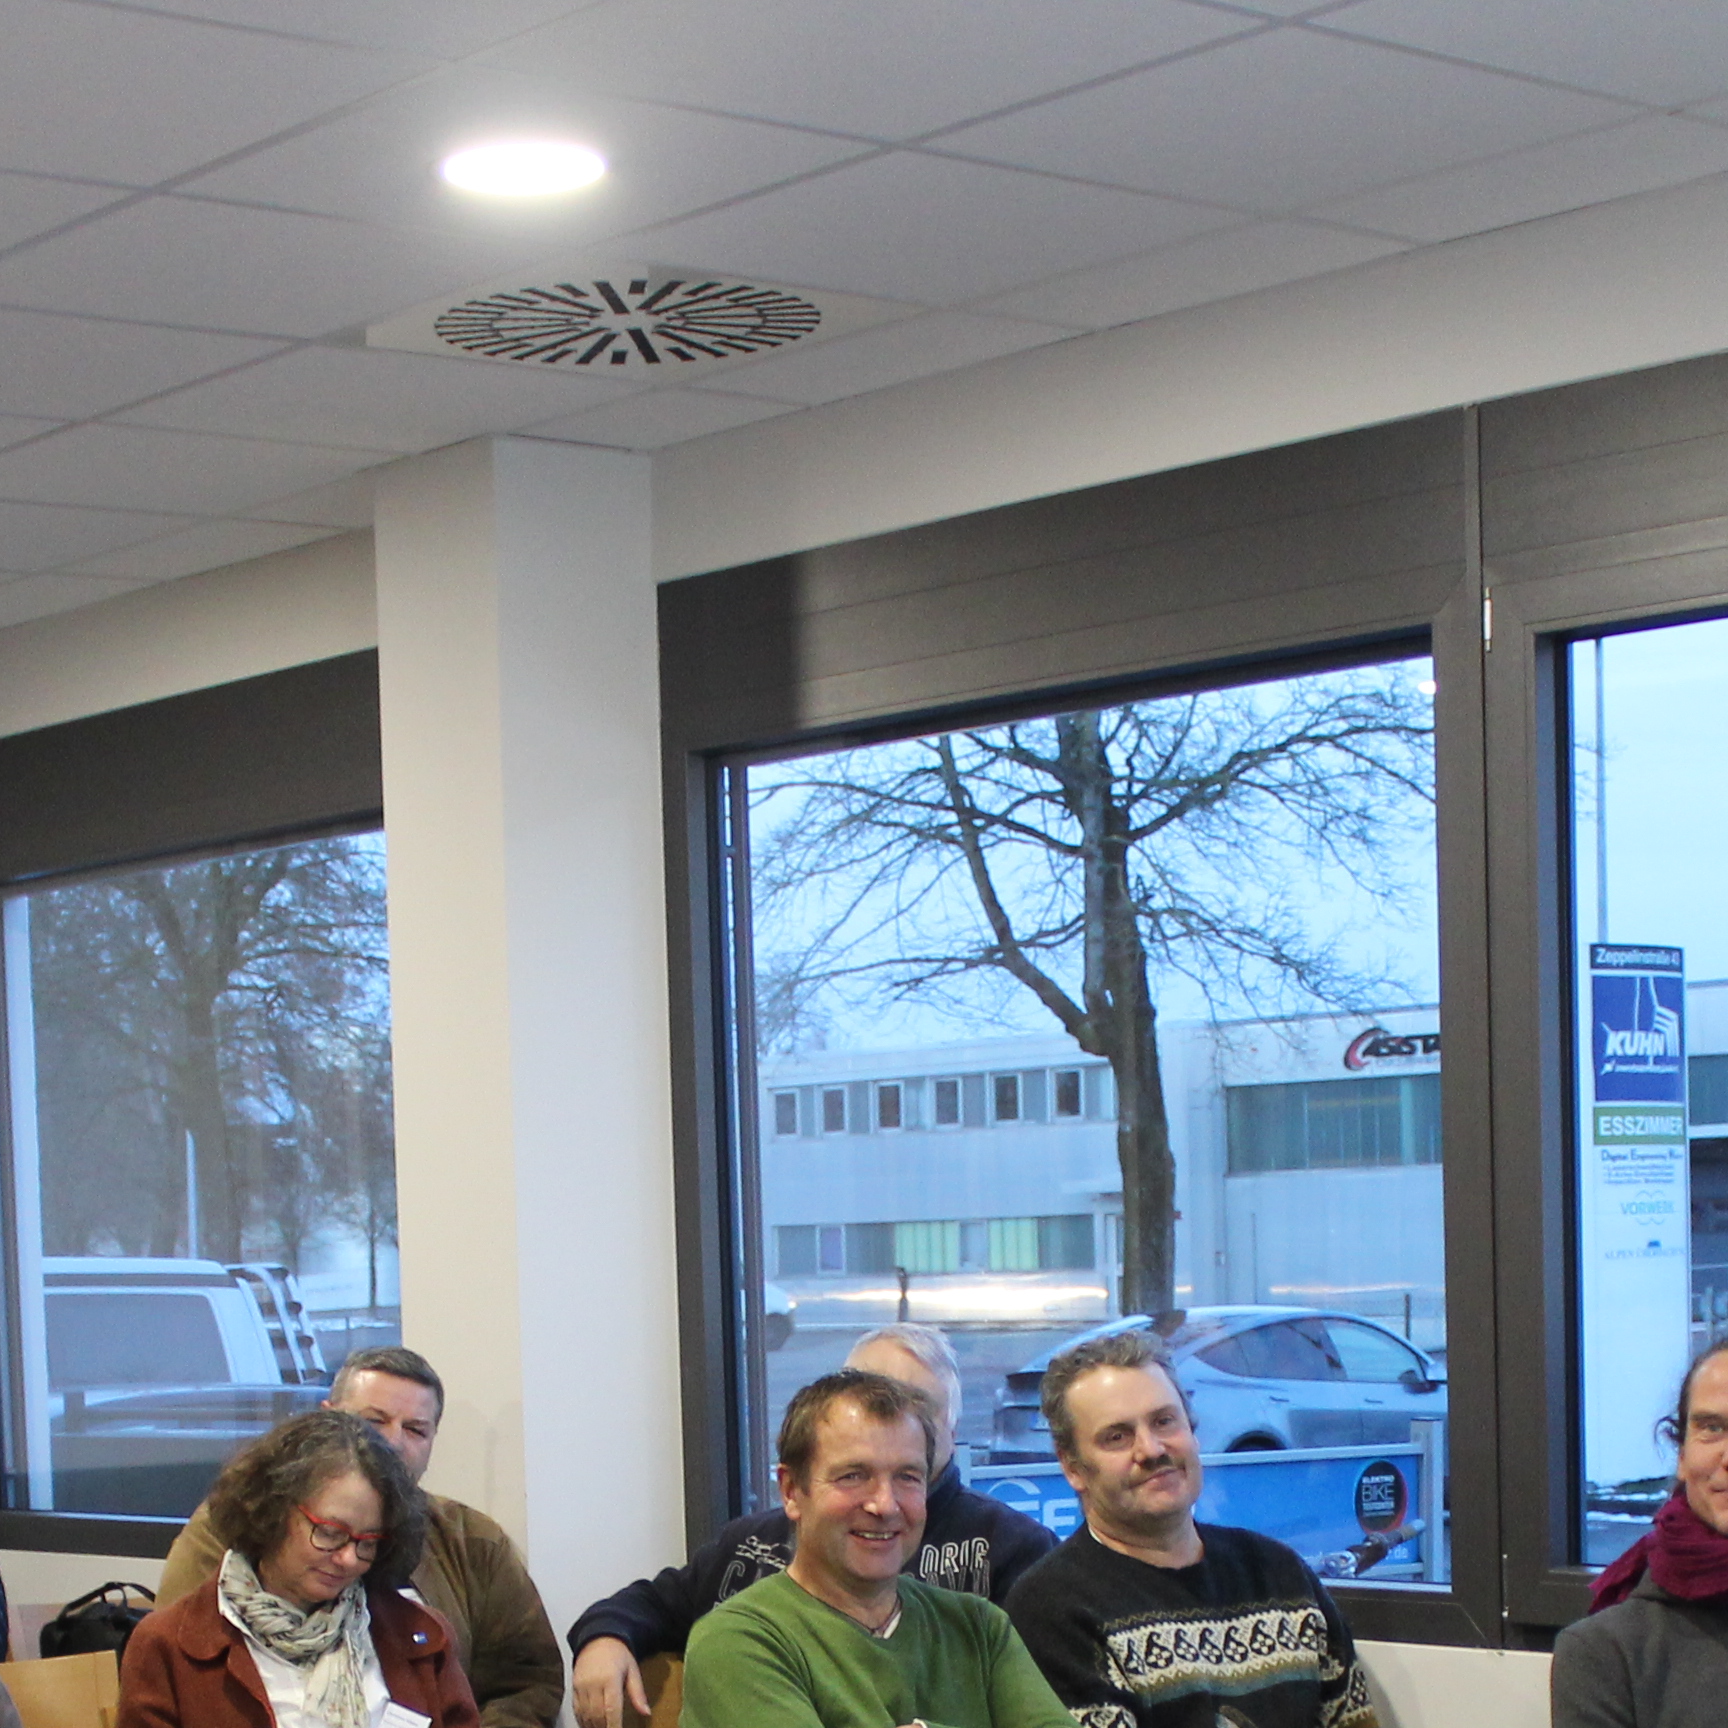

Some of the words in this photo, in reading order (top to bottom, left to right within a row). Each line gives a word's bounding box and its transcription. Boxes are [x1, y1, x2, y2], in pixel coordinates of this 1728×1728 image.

[1605, 1030, 1665, 1057] KUHN
[1598, 1115, 1684, 1137] ESSZIMMER
[1362, 1485, 1394, 1501] BIKE
